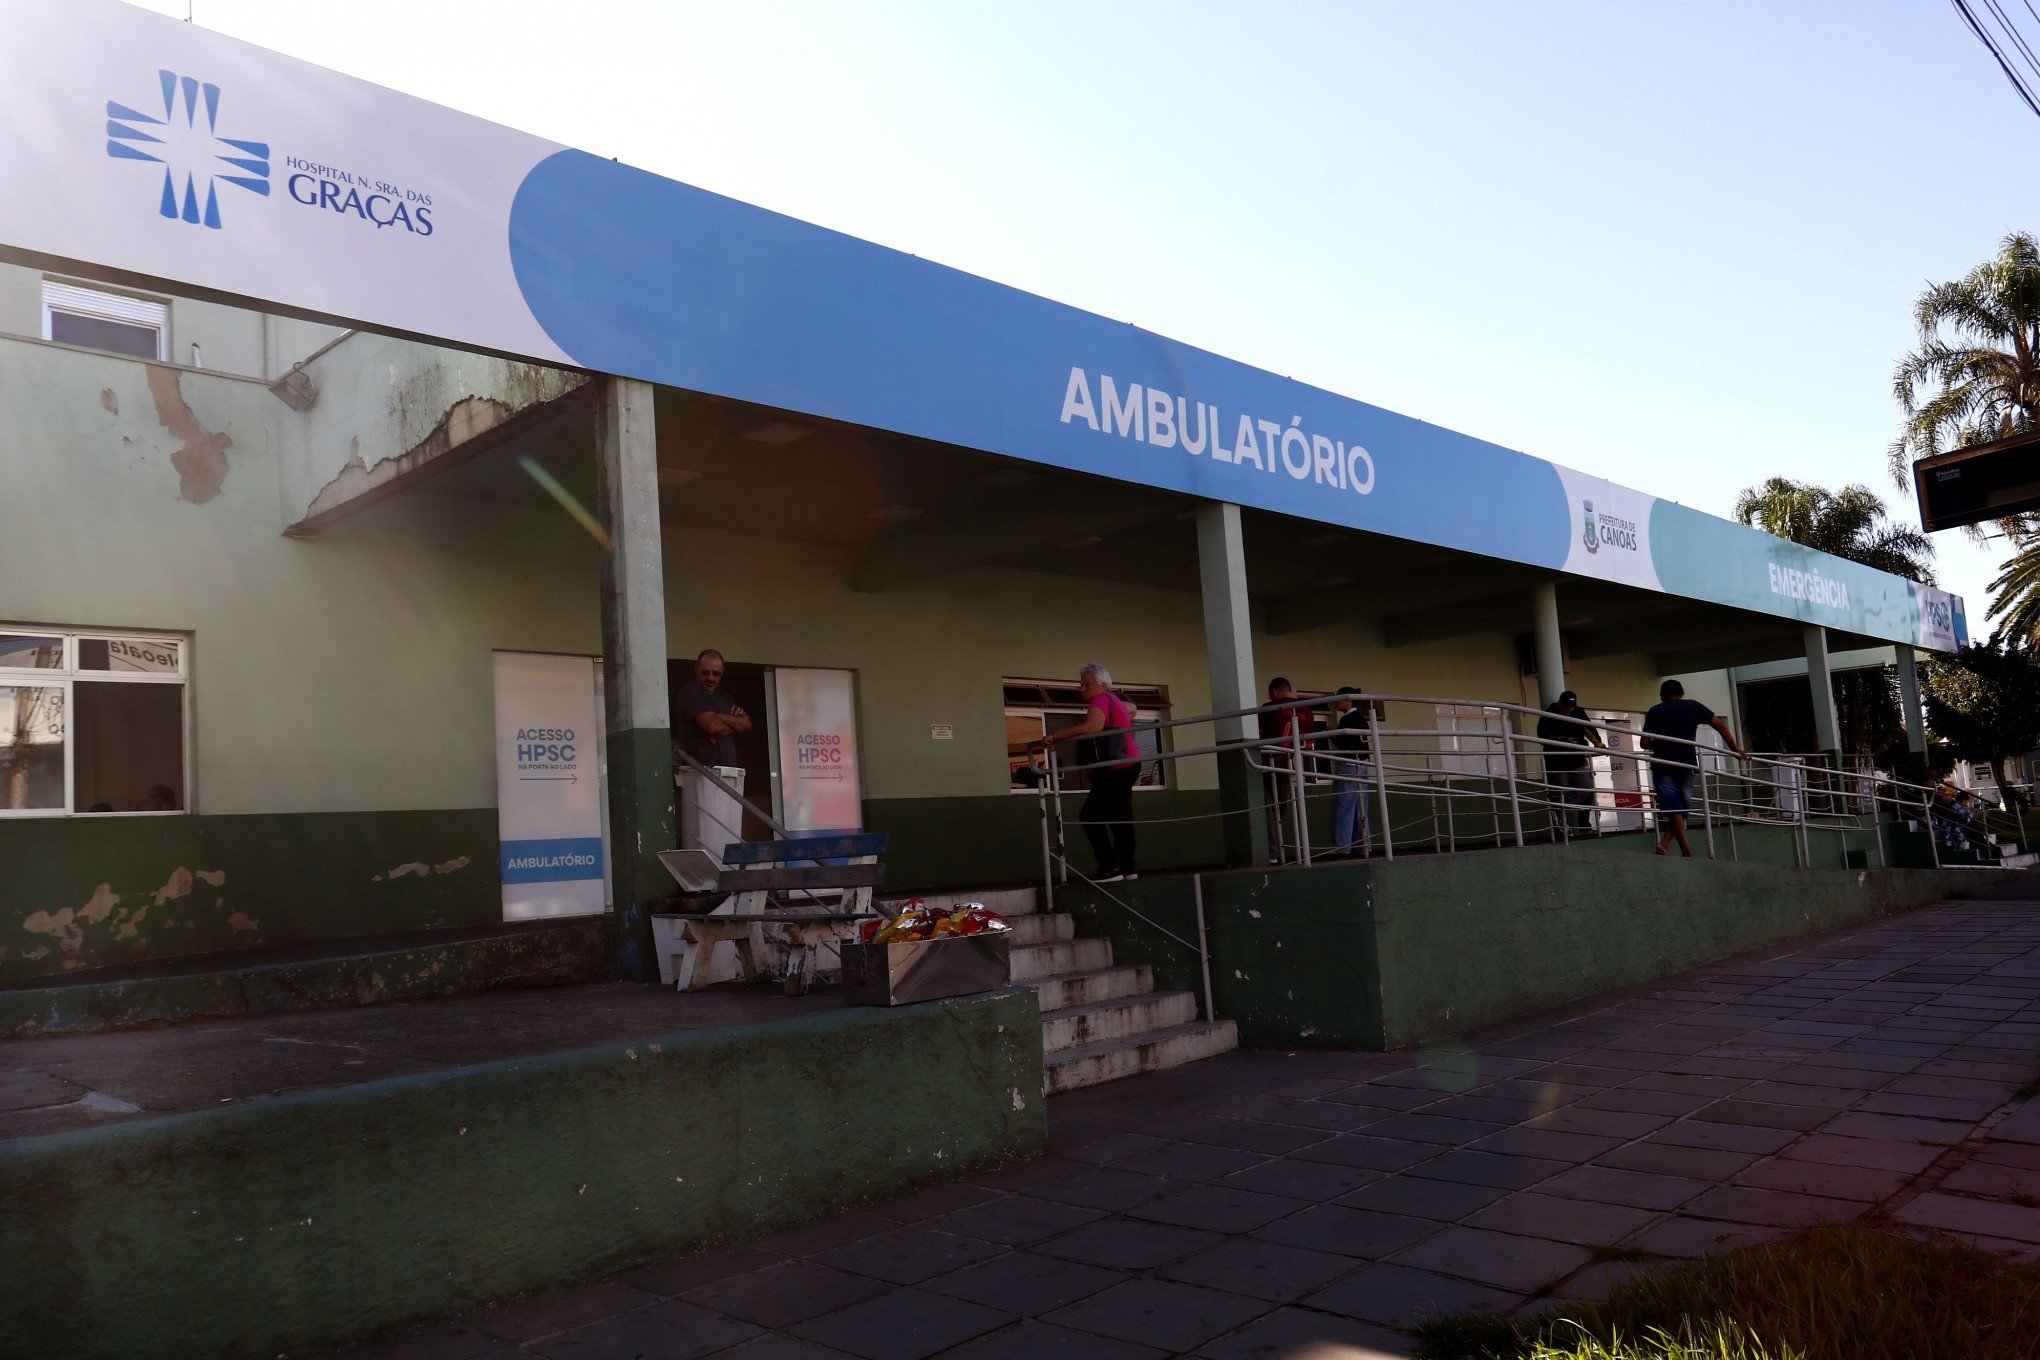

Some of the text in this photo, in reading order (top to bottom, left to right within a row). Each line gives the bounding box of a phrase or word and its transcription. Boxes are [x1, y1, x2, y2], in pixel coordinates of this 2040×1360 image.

[286, 155, 433, 206] HOSPITAL N. SRA. DAS
[288, 173, 434, 236] GRAÇAS
[1059, 366, 1376, 496] AMBULATÓRIO
[1598, 513, 1636, 533] PREFEITURA DE
[1600, 524, 1638, 552] CANOAS
[1768, 562, 1851, 611] EMERGÊNCIA
[516, 728, 575, 742] ACESSO
[797, 734, 841, 746] ACESSO
[517, 744, 577, 762] HPSC
[798, 747, 842, 763] HPSC
[507, 852, 595, 870] AMBULATÓRIO
